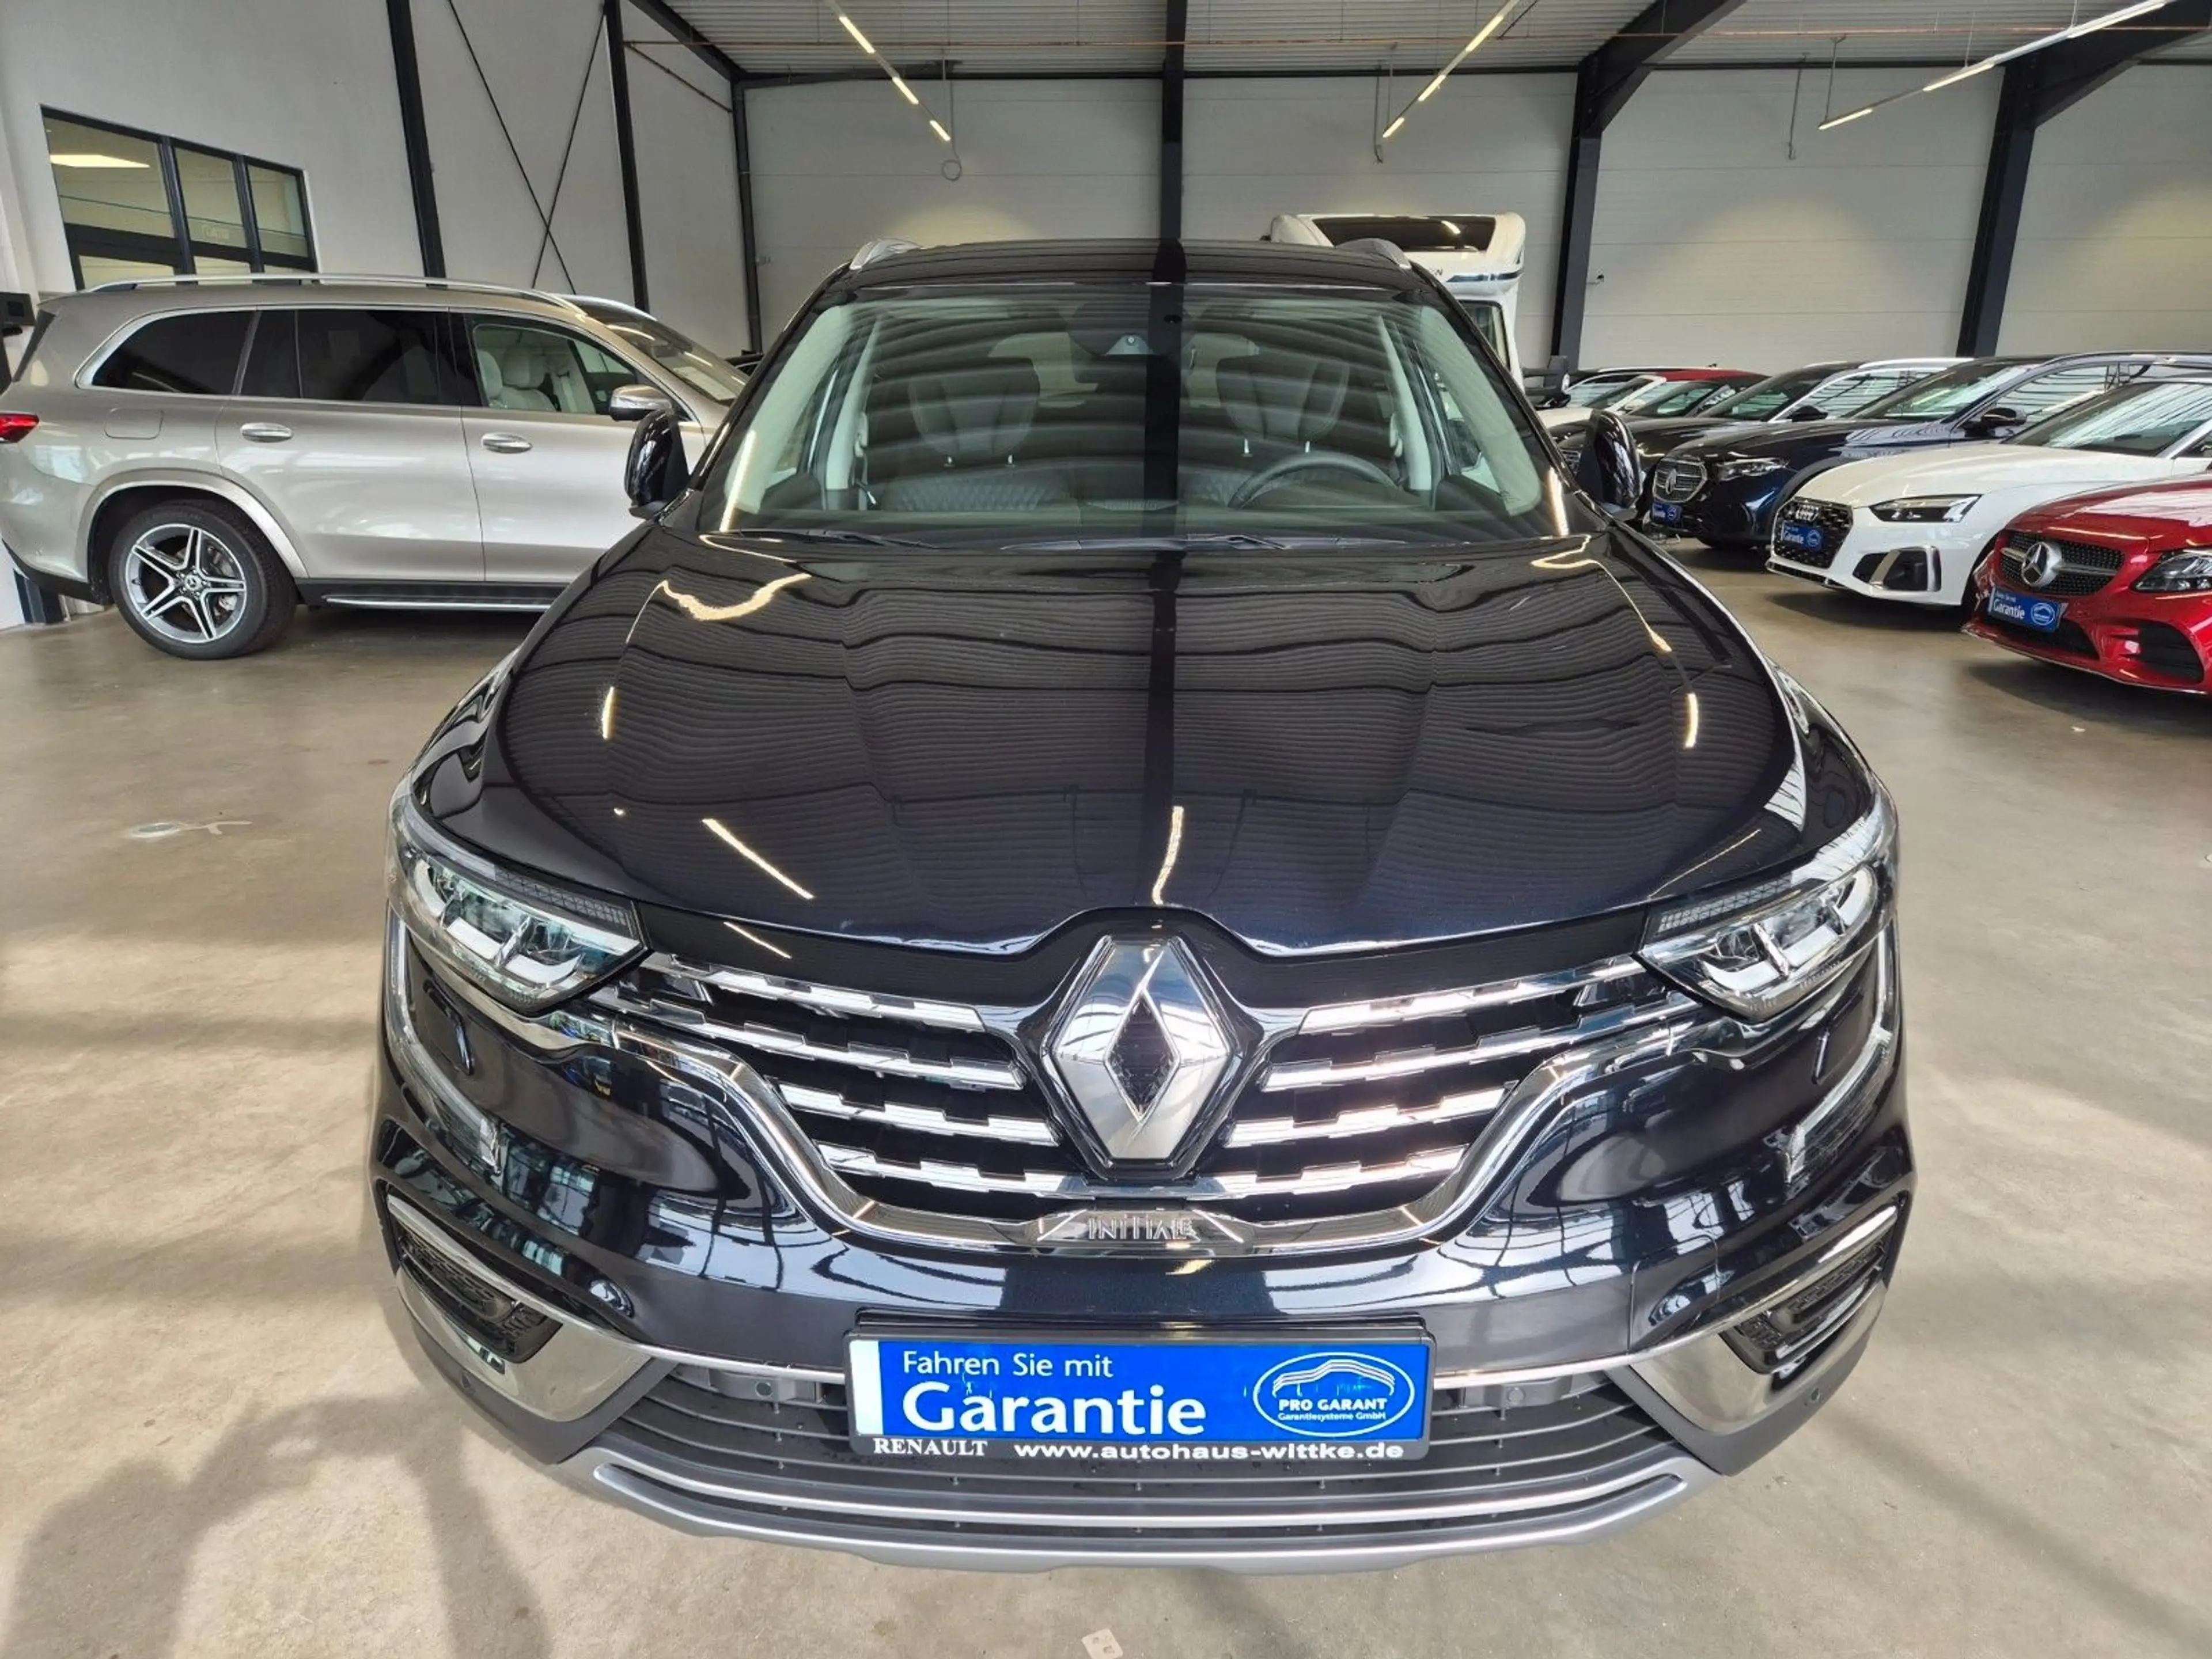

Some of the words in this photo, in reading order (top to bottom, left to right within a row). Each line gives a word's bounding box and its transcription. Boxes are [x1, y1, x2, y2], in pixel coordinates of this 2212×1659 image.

[904, 1350, 1000, 1376] Fahren
[1013, 1353, 1054, 1376] Sie
[1065, 1354, 1113, 1378] mit
[903, 1381, 1207, 1436] Garantie
[1278, 1398, 1313, 1411] PRO
[1317, 1397, 1388, 1411] GARANT
[1355, 1411, 1386, 1421] GmbH
[873, 1438, 988, 1456] RENAULT
[1014, 1443, 1404, 1460] www.autohaus-wittke.de
